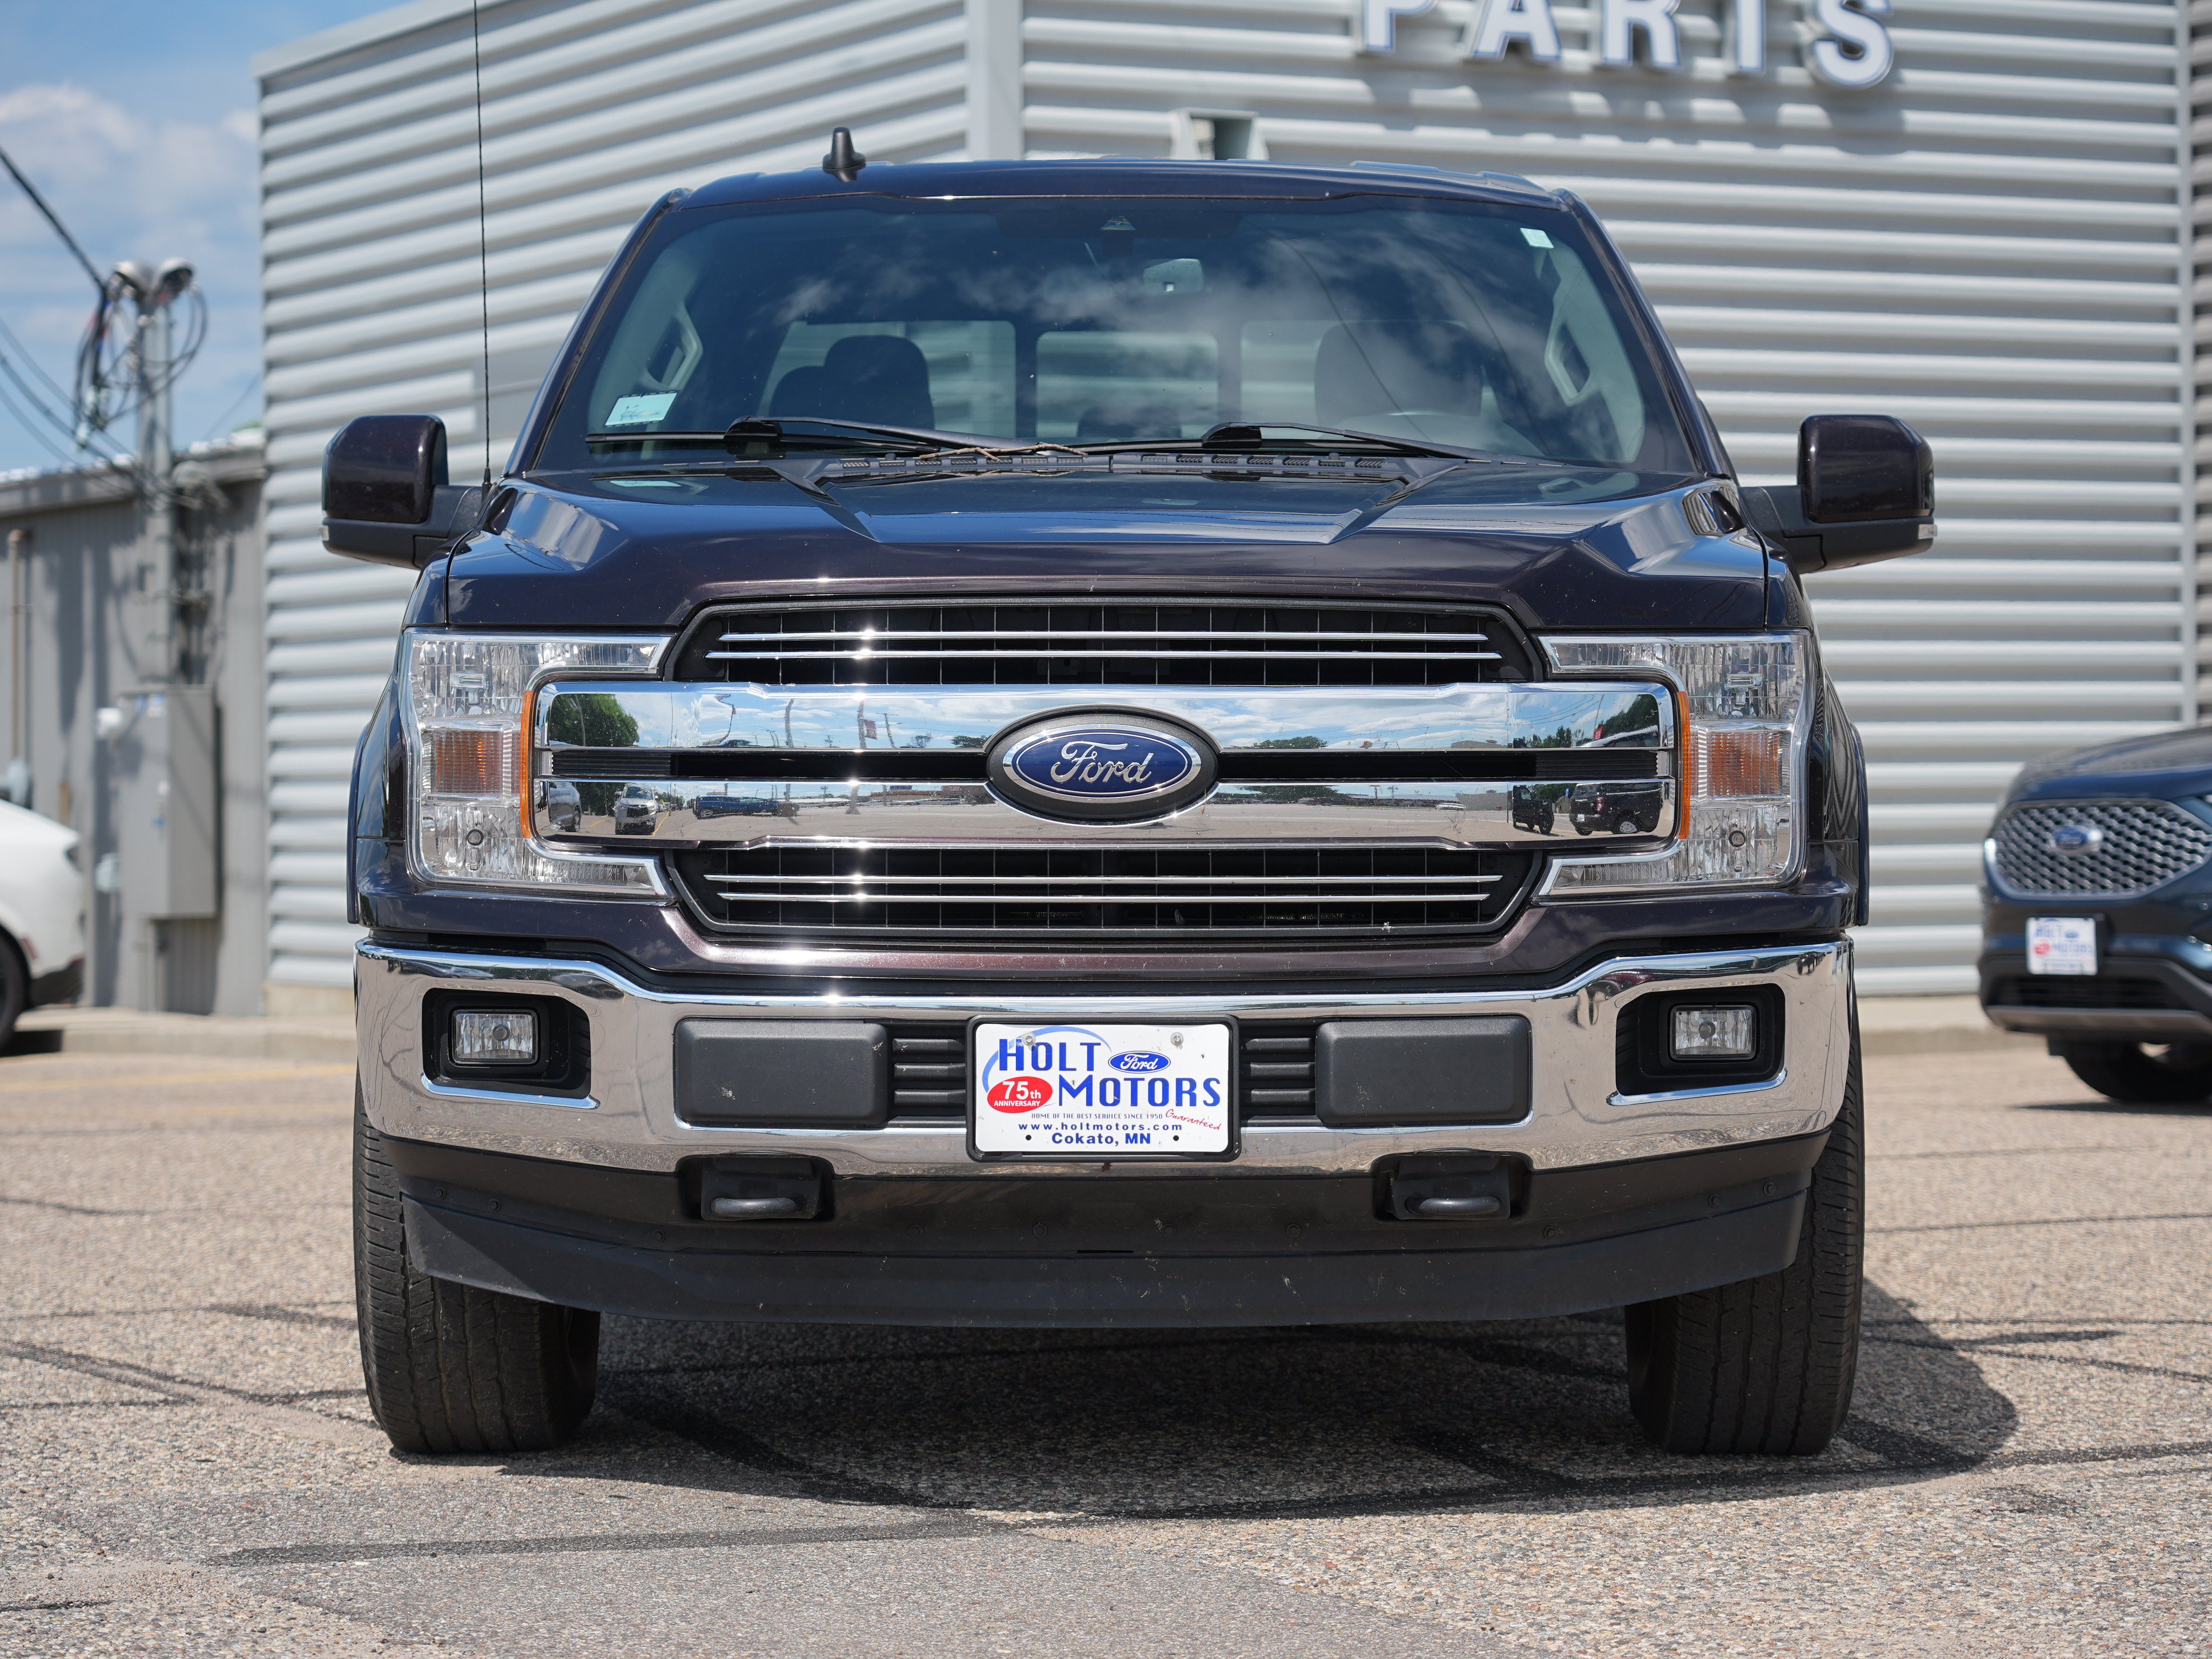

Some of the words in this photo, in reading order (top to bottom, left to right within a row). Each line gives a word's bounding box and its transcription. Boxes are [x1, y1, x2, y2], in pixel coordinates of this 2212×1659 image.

[1050, 740, 1154, 783] Ford
[999, 1038, 1101, 1071] HOLT
[1120, 1054, 1159, 1070] Ford
[1002, 1081, 1041, 1100] 75th
[1059, 1074, 1220, 1107] MOTORS
[1019, 1122, 1182, 1130] www.holtmotors.com
[1165, 1109, 1222, 1130] Guaranteed
[1051, 1132, 1119, 1147] Cokato,
[1125, 1132, 1151, 1144] MN
